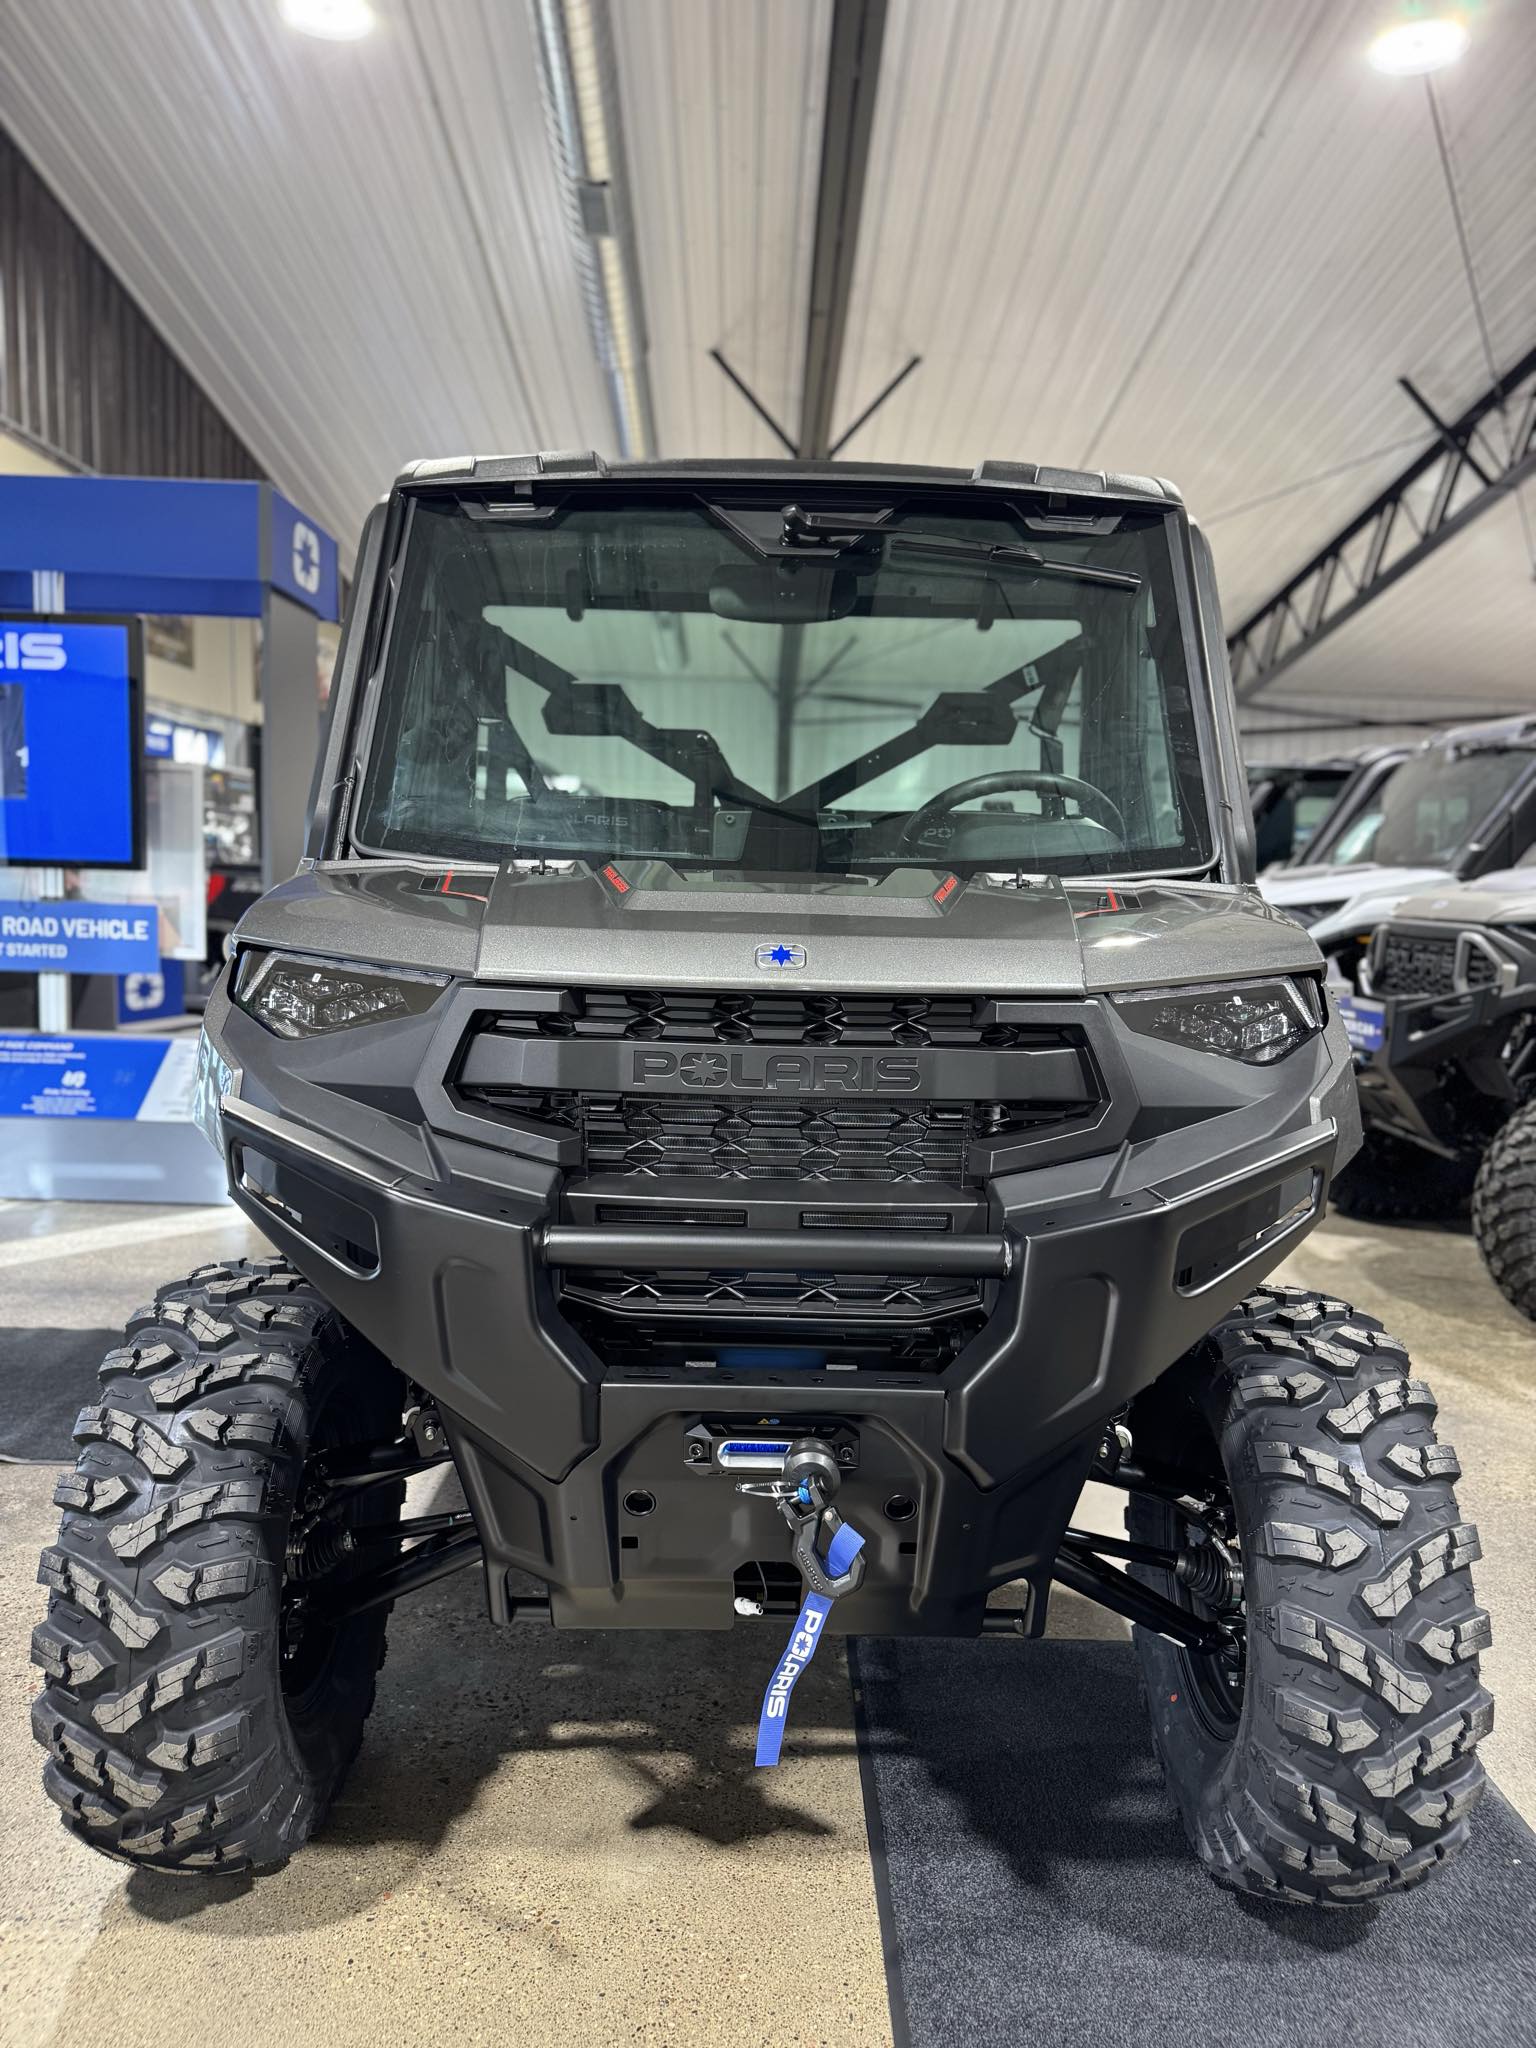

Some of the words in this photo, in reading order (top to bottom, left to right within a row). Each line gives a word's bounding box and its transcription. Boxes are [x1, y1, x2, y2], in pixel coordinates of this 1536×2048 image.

[2, 916, 59, 937] ROAD
[61, 917, 149, 941] VEHICLE
[5, 942, 68, 959] STARTED
[632, 1050, 922, 1092] POLARIS
[766, 1609, 823, 1718] POLARIS
